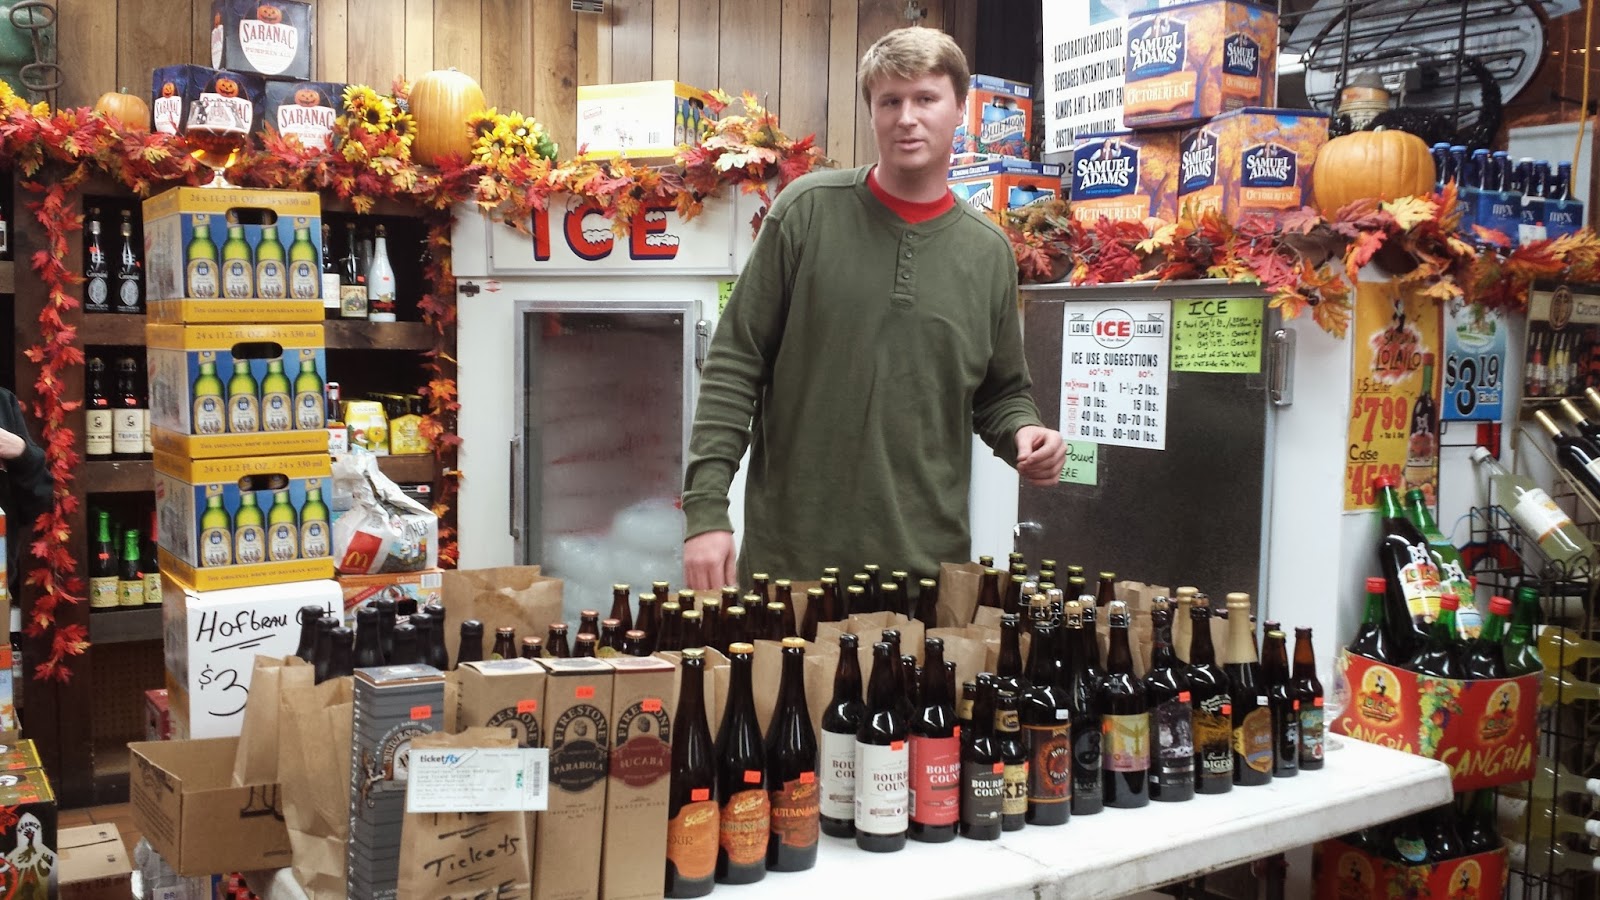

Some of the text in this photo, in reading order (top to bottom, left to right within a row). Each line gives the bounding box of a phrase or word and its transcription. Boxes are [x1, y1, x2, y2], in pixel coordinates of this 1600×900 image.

[243, 23, 295, 49] SARANAC
[1058, 36, 1090, 63] DECORATIVE
[1090, 31, 1105, 53] SHOT
[1106, 26, 1122, 49] SLIDE
[1129, 31, 1182, 58] SAMUEL
[1131, 47, 1177, 71] ADAMS
[1227, 43, 1257, 61] SAMUEL
[1228, 55, 1254, 71] ADAMS
[1054, 57, 1120, 92] BEVERAGES INSTANTLY CHILL
[1127, 81, 1193, 104] OCTOBERFEST
[1055, 99, 1072, 120] ALWAYS
[1098, 89, 1114, 110] PARTY
[281, 108, 334, 130] SARANAC
[981, 122, 1003, 139] BLUE
[1005, 114, 1025, 130] MOON
[1056, 127, 1074, 148] CUSTOM
[1077, 156, 1134, 176] SAMUEL
[1182, 145, 1215, 169] SAMUEL
[1246, 154, 1291, 170] SAMUEL
[1080, 171, 1130, 190] ADAMS
[1183, 161, 1212, 184] ADAMS
[1249, 167, 1288, 181] ADAMS
[1246, 189, 1296, 201] OCTOBERFEST
[531, 196, 680, 262] ICE
[1188, 300, 1228, 316] ICE
[1072, 324, 1162, 334] LONG ISLAND
[1096, 321, 1131, 337] ICE
[1071, 352, 1158, 367] ICE USE SUGGESTIONS
[1093, 381, 1096, 392] 1
[1099, 382, 1108, 392] lb.
[1145, 384, 1159, 396] lbs.
[1083, 396, 1159, 412] 10 lbs. 15 lbs.
[1081, 410, 1158, 427] 40 lbs. 60-70 lbs.
[1080, 425, 1157, 443] 60 lbs. 80-100 lbs.
[1349, 444, 1378, 461] Case
[554, 707, 607, 741] FIRESTONE
[420, 754, 461, 764] ticketfly
[620, 755, 664, 768] SUCABA
[1438, 734, 1533, 780] SANGRIA
[553, 761, 604, 775] PARABOLA
[773, 807, 804, 818] AUTUMN
[424, 834, 520, 878] Tickets
